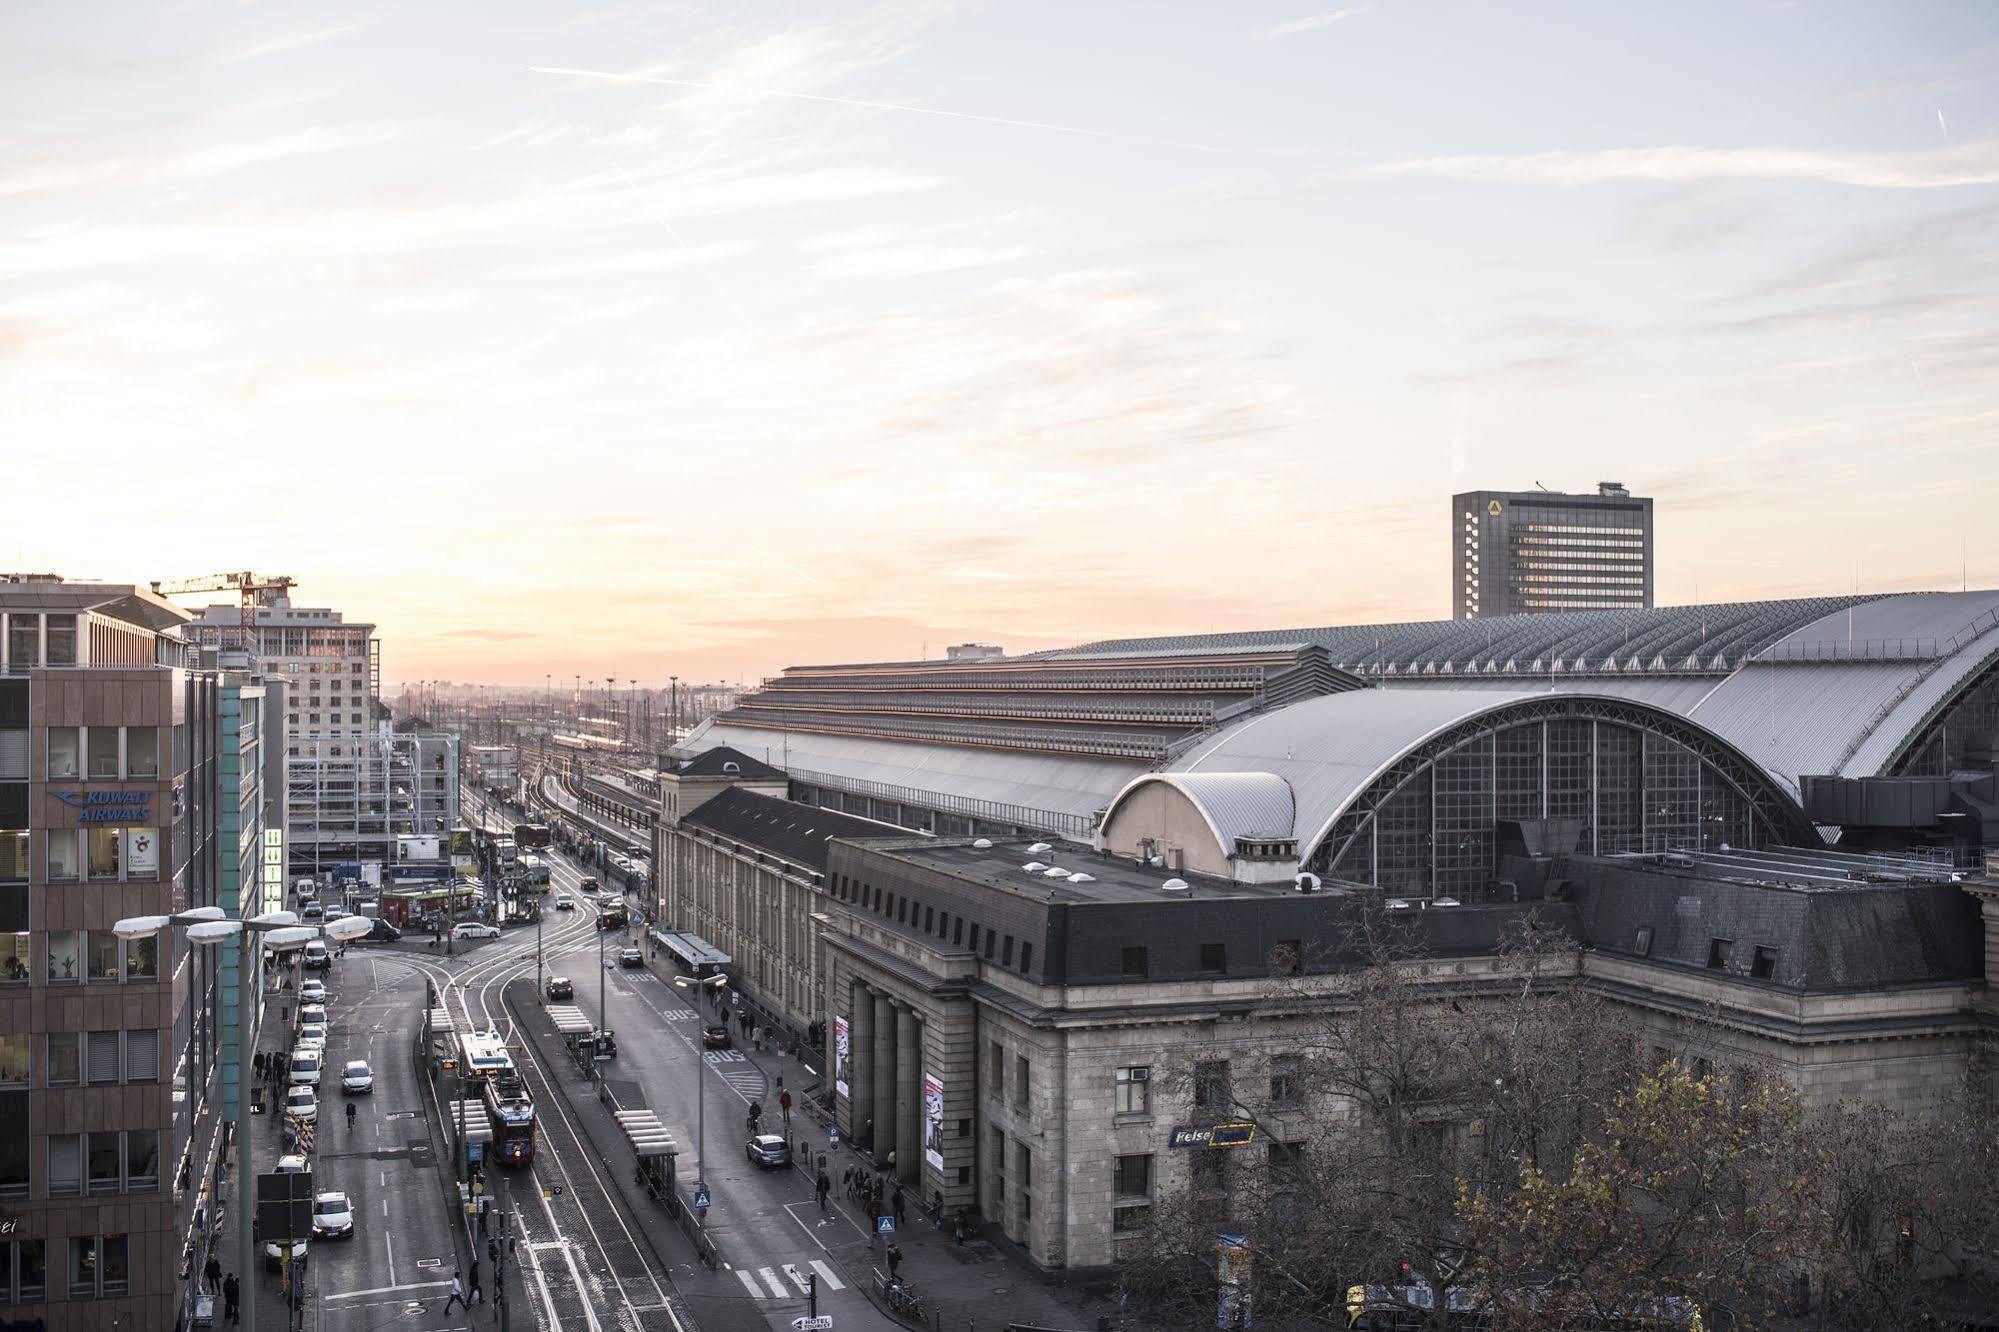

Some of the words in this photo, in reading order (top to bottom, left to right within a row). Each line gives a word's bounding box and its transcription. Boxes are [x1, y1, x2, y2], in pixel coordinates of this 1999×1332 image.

[87, 791, 152, 804] KUWAIT
[78, 807, 150, 822] AIRWAYS
[626, 973, 658, 982] BUS
[663, 1009, 700, 1021] BUS
[703, 1049, 747, 1063] BUS
[830, 1128, 837, 1137] P
